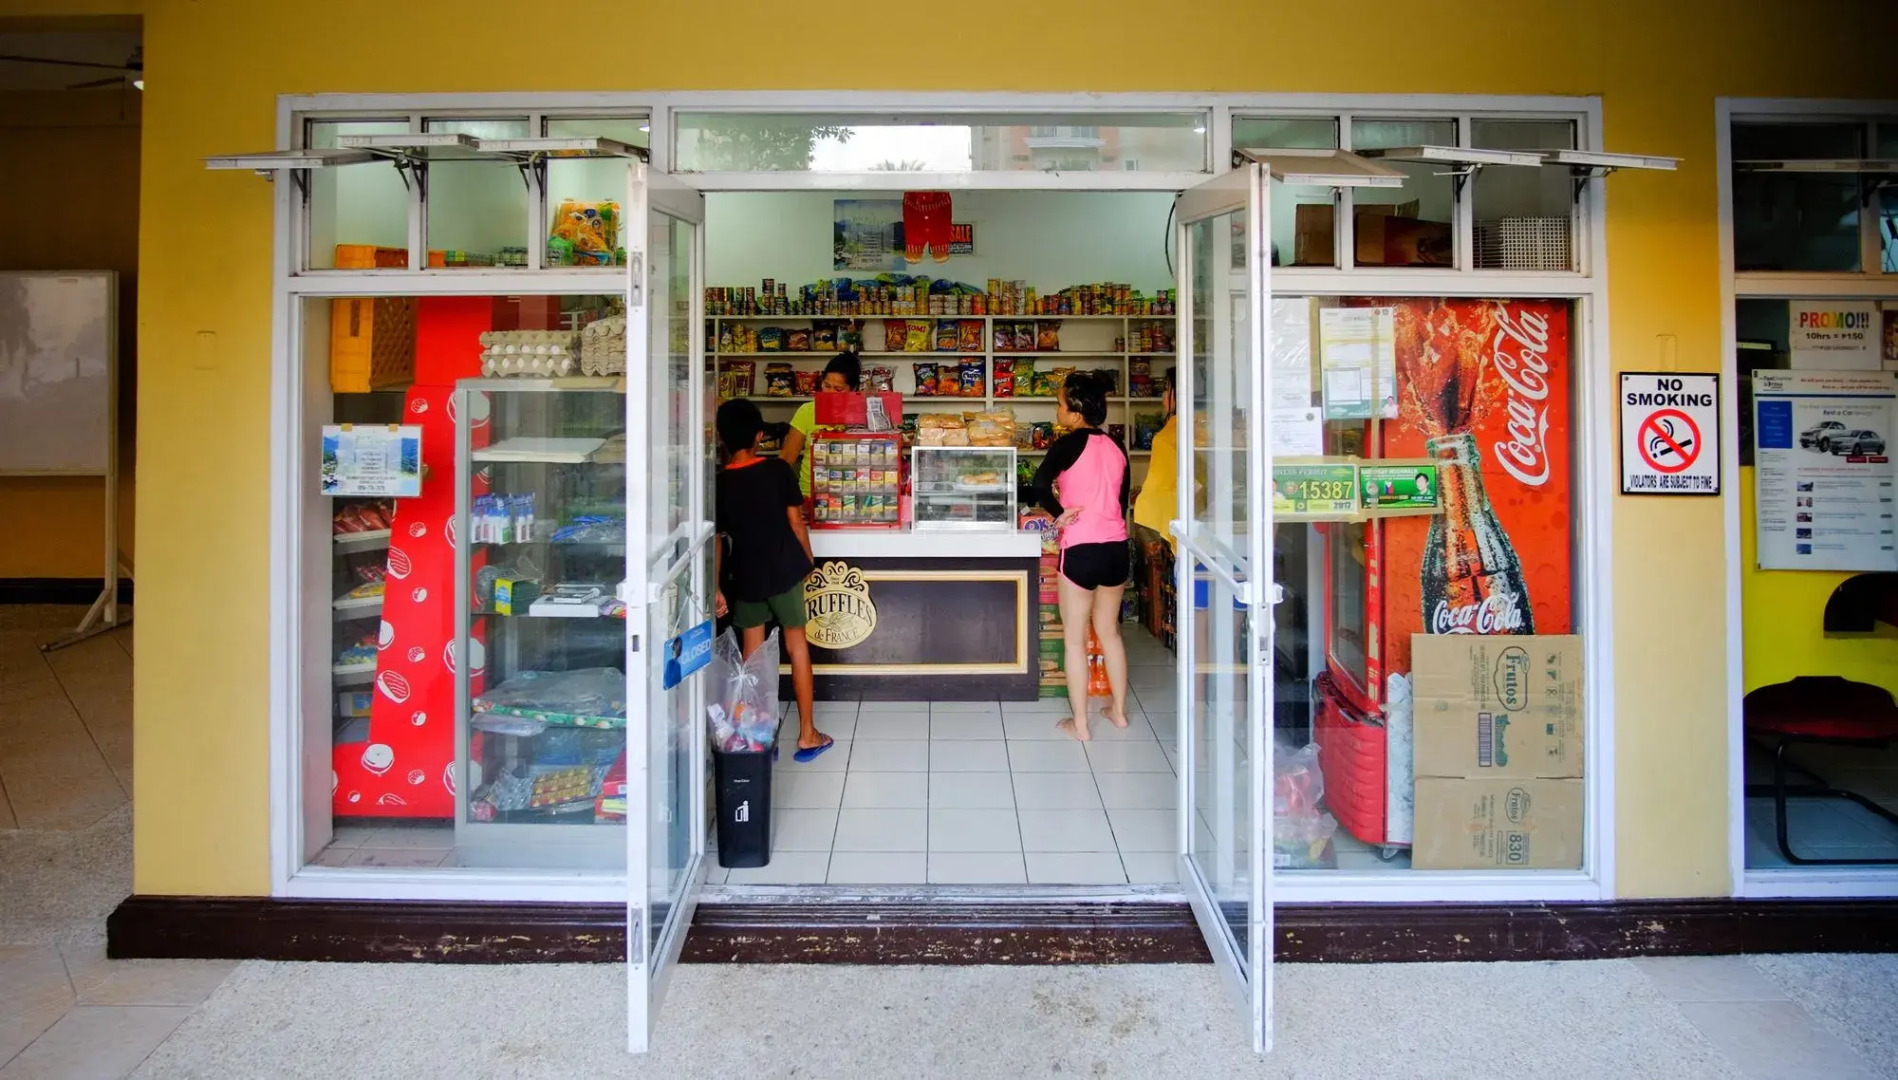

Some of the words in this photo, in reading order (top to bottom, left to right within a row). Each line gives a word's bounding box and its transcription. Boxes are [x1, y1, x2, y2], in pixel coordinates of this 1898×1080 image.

[1800, 312, 1869, 328] PROMO!!!
[1493, 302, 1550, 487] Coca-Cola
[1657, 378, 1684, 391] NO
[1626, 393, 1713, 407] SMOKING
[1299, 481, 1353, 499] 15387
[1630, 474, 1657, 488] VIOLATORS
[1659, 475, 1669, 488] ARE
[1670, 475, 1692, 489] SUBJECT
[1693, 475, 1700, 489] TO
[1700, 475, 1712, 489] FINE
[1432, 592, 1523, 634] Coca-Cola
[814, 630, 824, 641] de
[825, 627, 858, 643] FRANCE
[681, 639, 712, 665] CLOSED
[1506, 654, 1521, 704] Frutos
[1511, 792, 1521, 820] Frutos
[1508, 834, 1522, 861] 830
